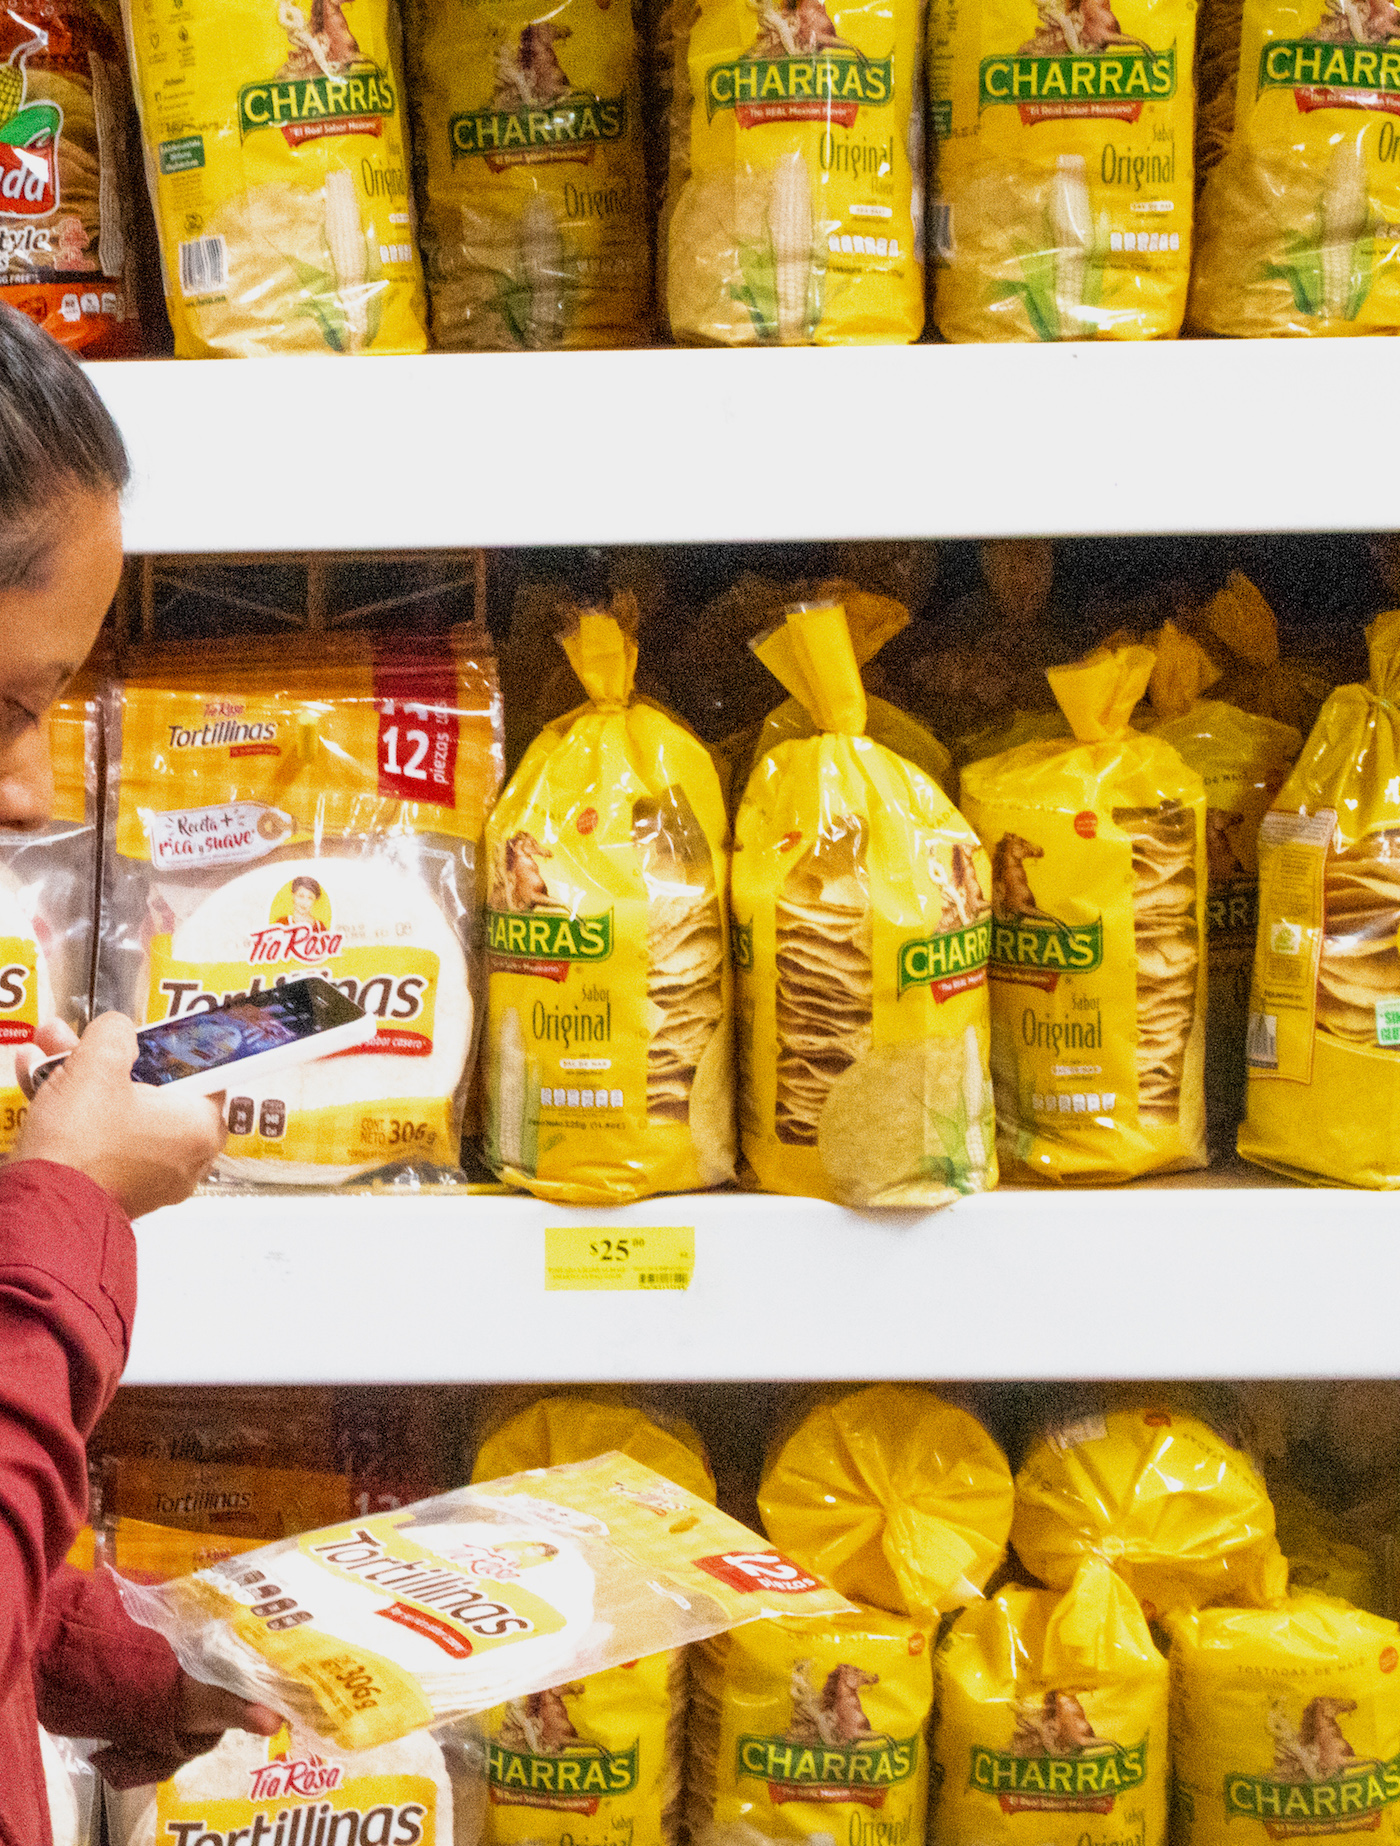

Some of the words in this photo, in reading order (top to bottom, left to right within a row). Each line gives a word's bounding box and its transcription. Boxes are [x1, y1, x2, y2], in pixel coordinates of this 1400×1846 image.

[710, 63, 888, 102] CHARRAS
[985, 59, 1172, 98] CHARRAS
[243, 78, 394, 123] CHARRAS
[453, 106, 620, 149] CHARRAS
[819, 130, 894, 180] Original
[1100, 142, 1176, 192] Original
[168, 720, 276, 747] Tortillinas
[381, 725, 430, 781] 12
[433, 731, 451, 785] piezas
[177, 815, 218, 837] Receta
[204, 830, 250, 851] suave
[283, 925, 343, 962] Rosa
[532, 999, 612, 1049] Original
[1022, 1008, 1103, 1058] Original
[312, 1528, 530, 1637] Tortillinas
[282, 1761, 341, 1796] Rosa
[741, 1741, 910, 1784] CHARRAS
[974, 1749, 1144, 1793] CHARRAS
